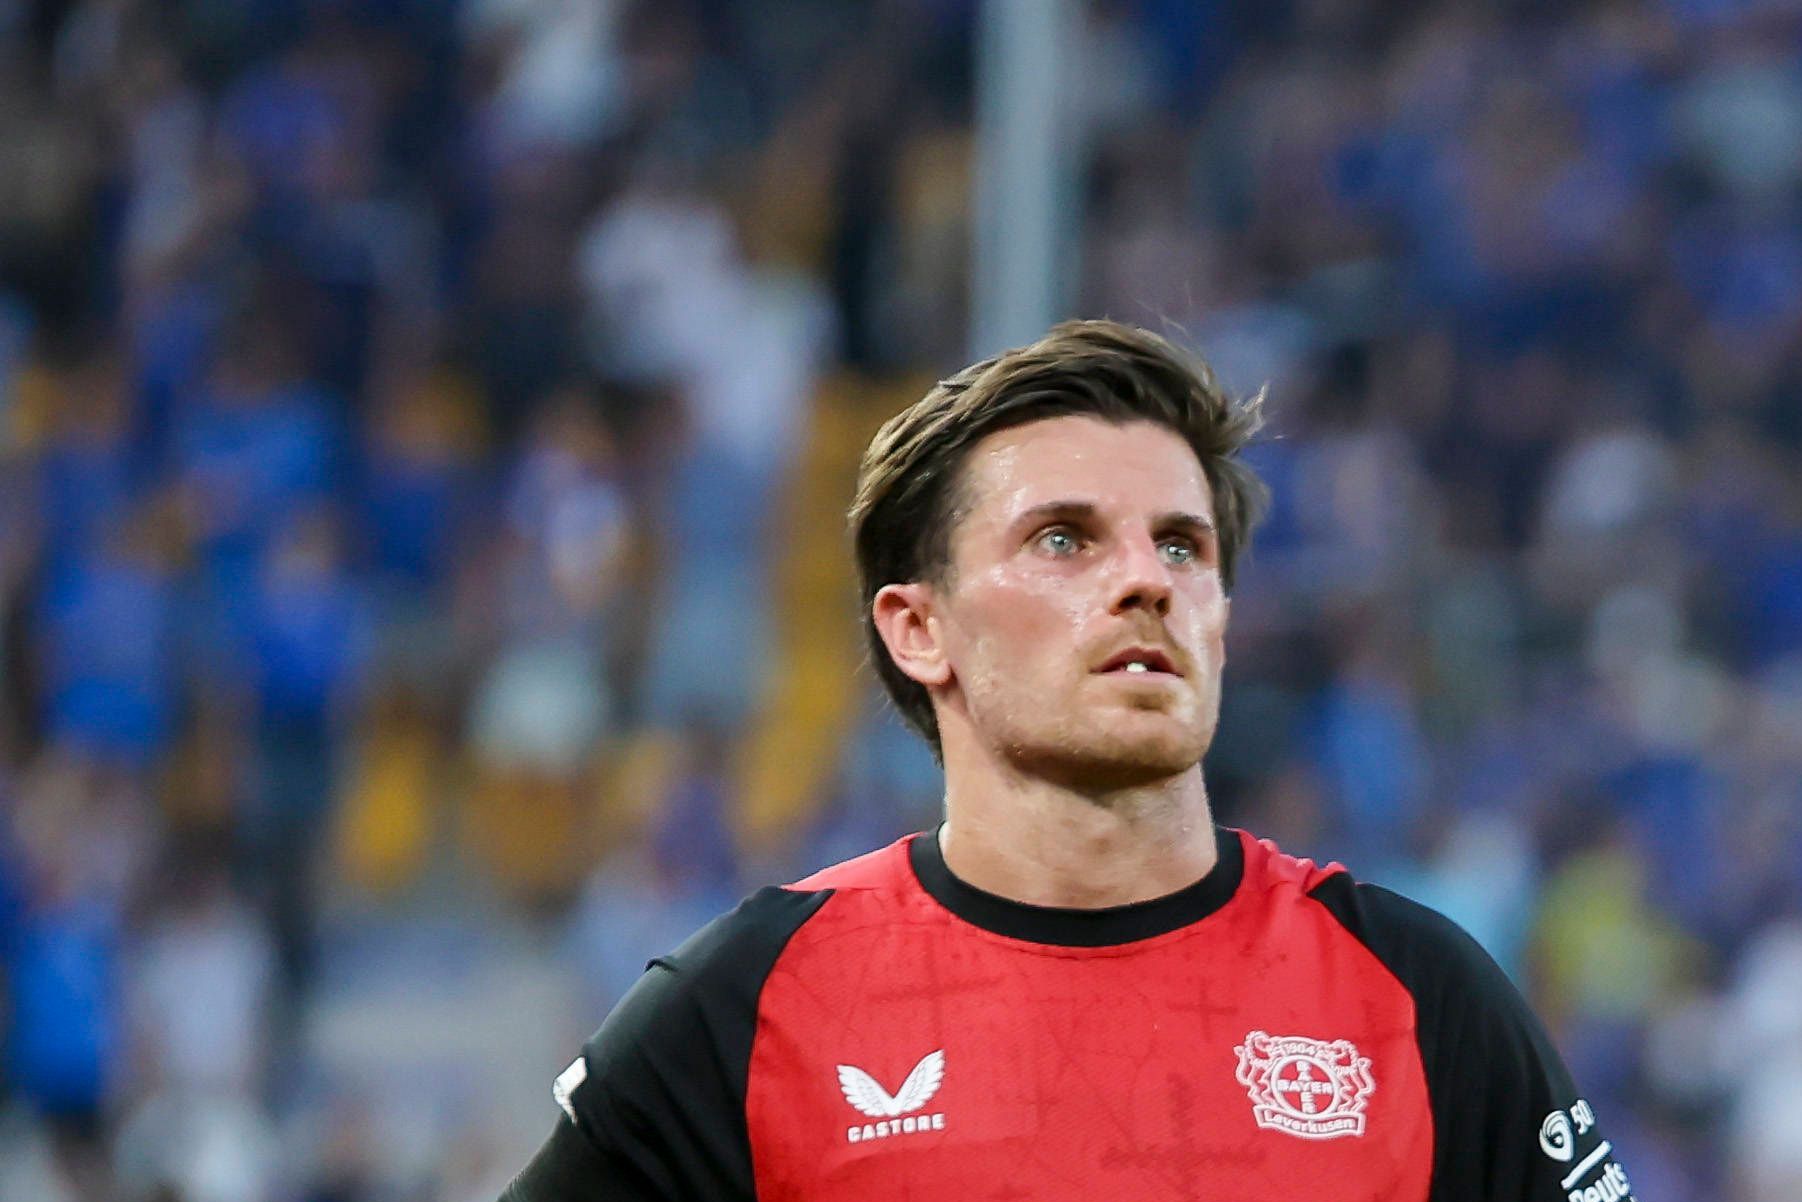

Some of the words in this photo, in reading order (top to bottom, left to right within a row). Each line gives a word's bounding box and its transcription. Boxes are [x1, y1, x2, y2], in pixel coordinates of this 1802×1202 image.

[1277, 1079, 1333, 1094] BAYER
[847, 1113, 945, 1144] CASTORE
[1264, 1109, 1354, 1134] Leverkusen
